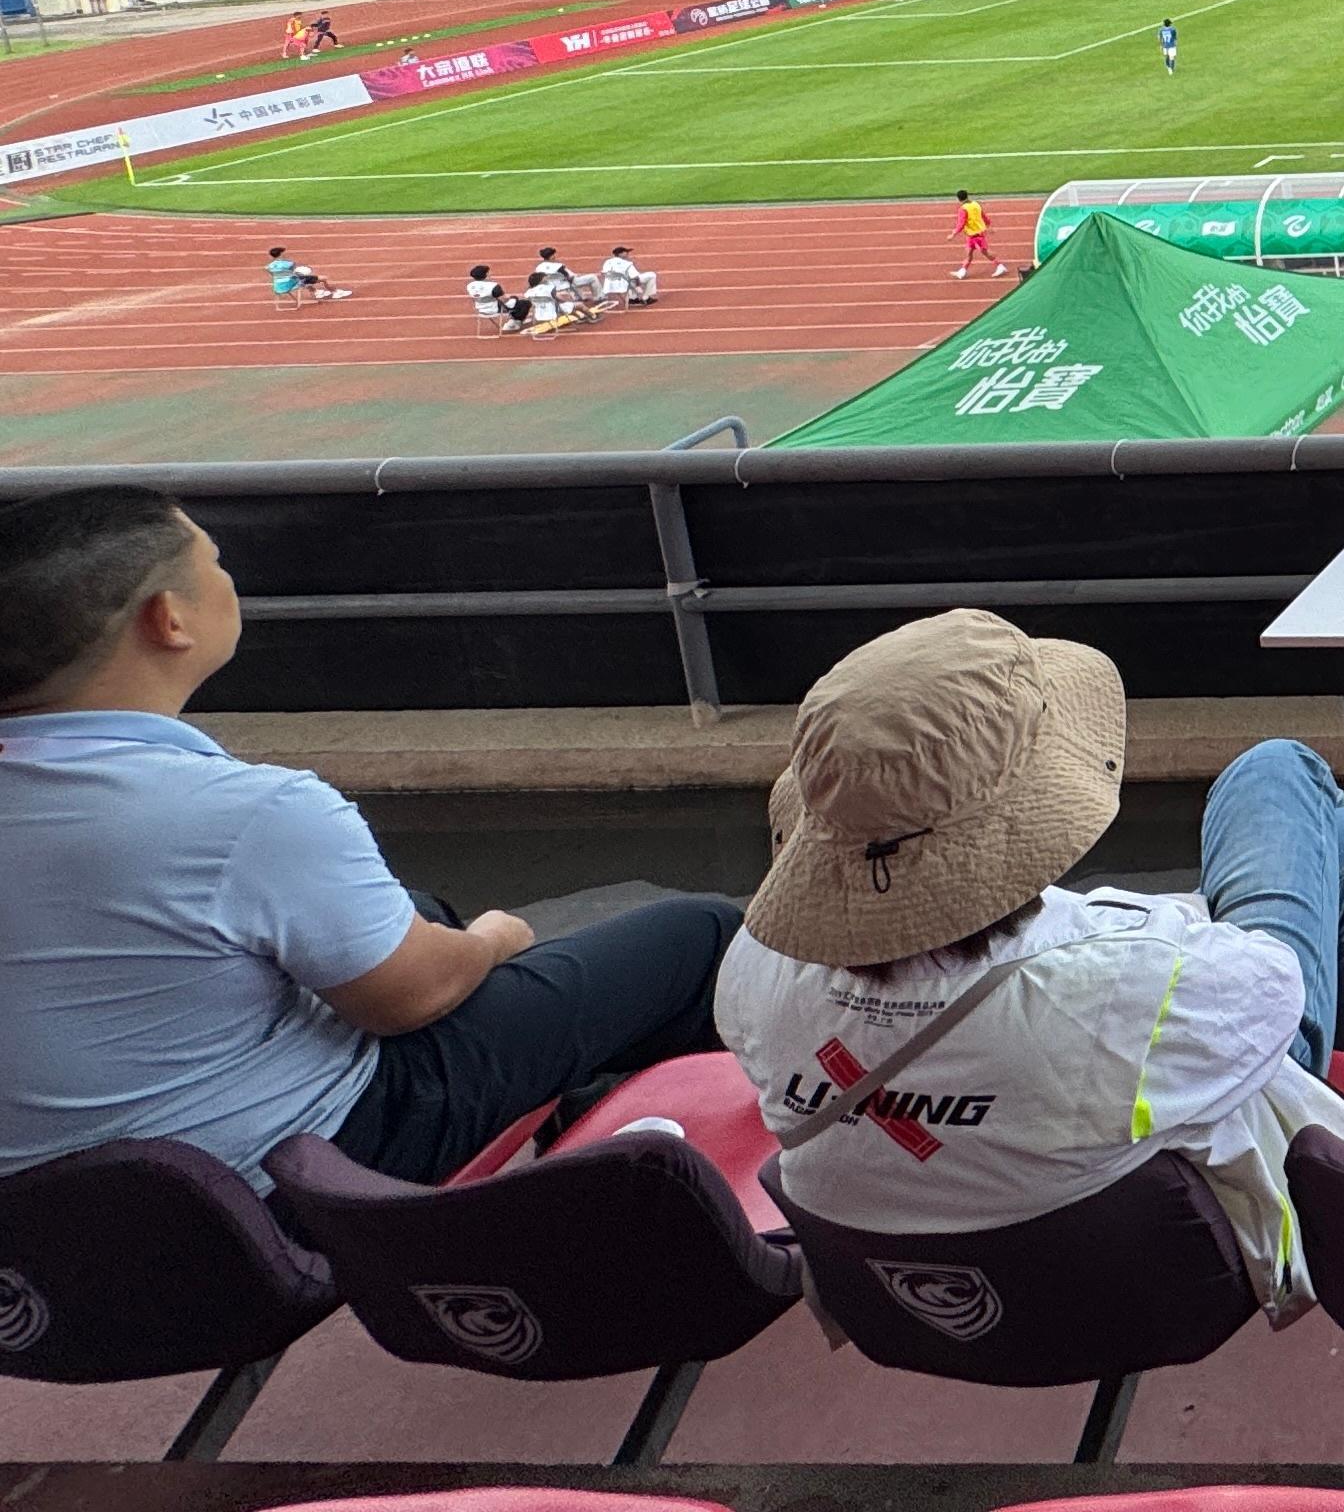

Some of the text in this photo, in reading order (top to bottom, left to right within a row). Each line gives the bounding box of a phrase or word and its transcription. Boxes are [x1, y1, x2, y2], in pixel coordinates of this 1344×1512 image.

[34, 133, 114, 157] STAR CHEF
[1178, 283, 1252, 337] 你我的
[1233, 284, 1311, 346] 怡寶
[948, 326, 1069, 370] 你我的
[955, 363, 1104, 416] 怡寶
[784, 1072, 997, 1126] LINING
